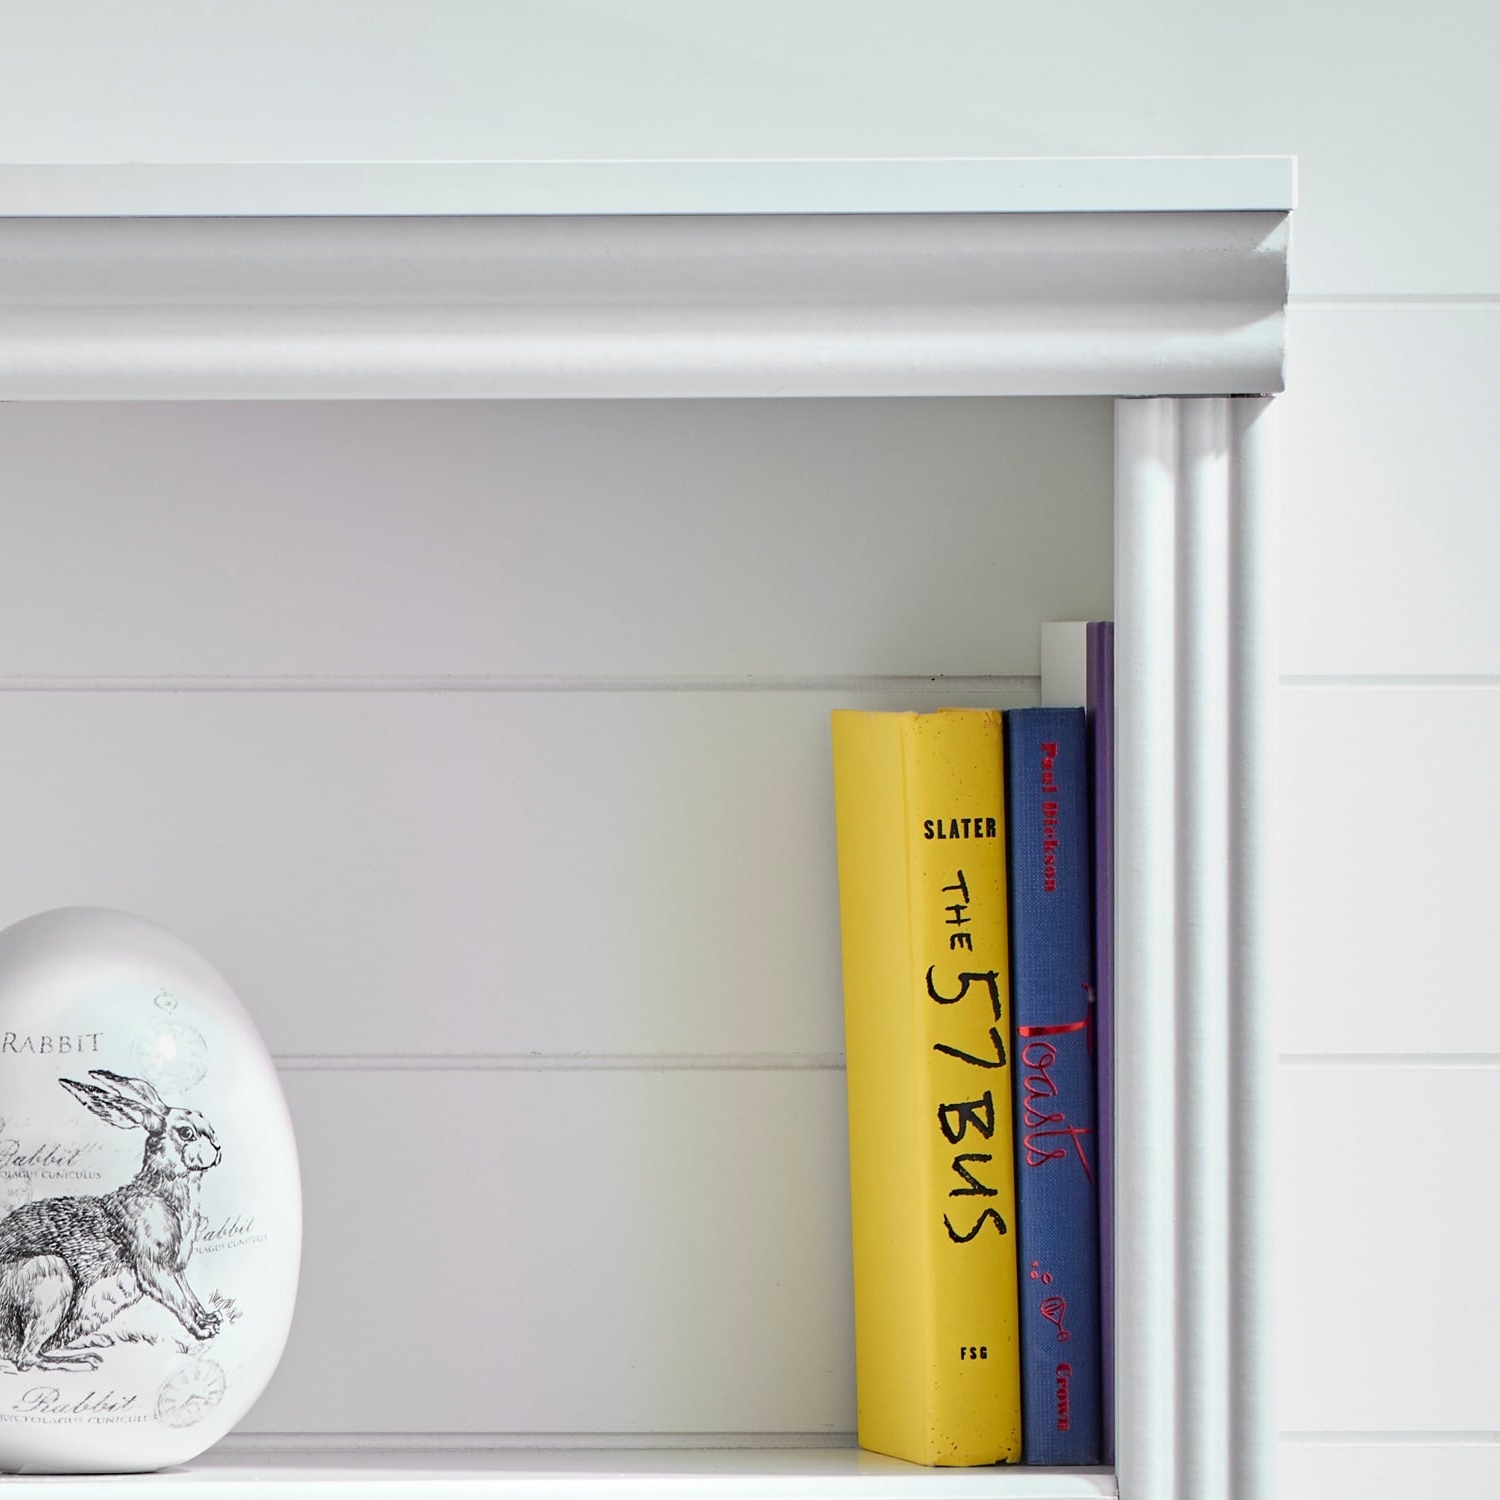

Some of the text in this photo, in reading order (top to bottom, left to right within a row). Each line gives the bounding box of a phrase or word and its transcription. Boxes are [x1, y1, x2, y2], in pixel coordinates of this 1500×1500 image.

[924, 817, 996, 840] SLATER
[1040, 742, 1060, 892] Paul Dickson
[2, 1032, 103, 1054] RABBIT
[926, 870, 1007, 1244] THE 57 BUS
[1017, 982, 1096, 1184] Toasts
[41, 1168, 101, 1180] CUNICULUS
[960, 1346, 988, 1361] FSG
[12, 1386, 137, 1414] Rabbit
[1056, 1362, 1073, 1432] Crown
